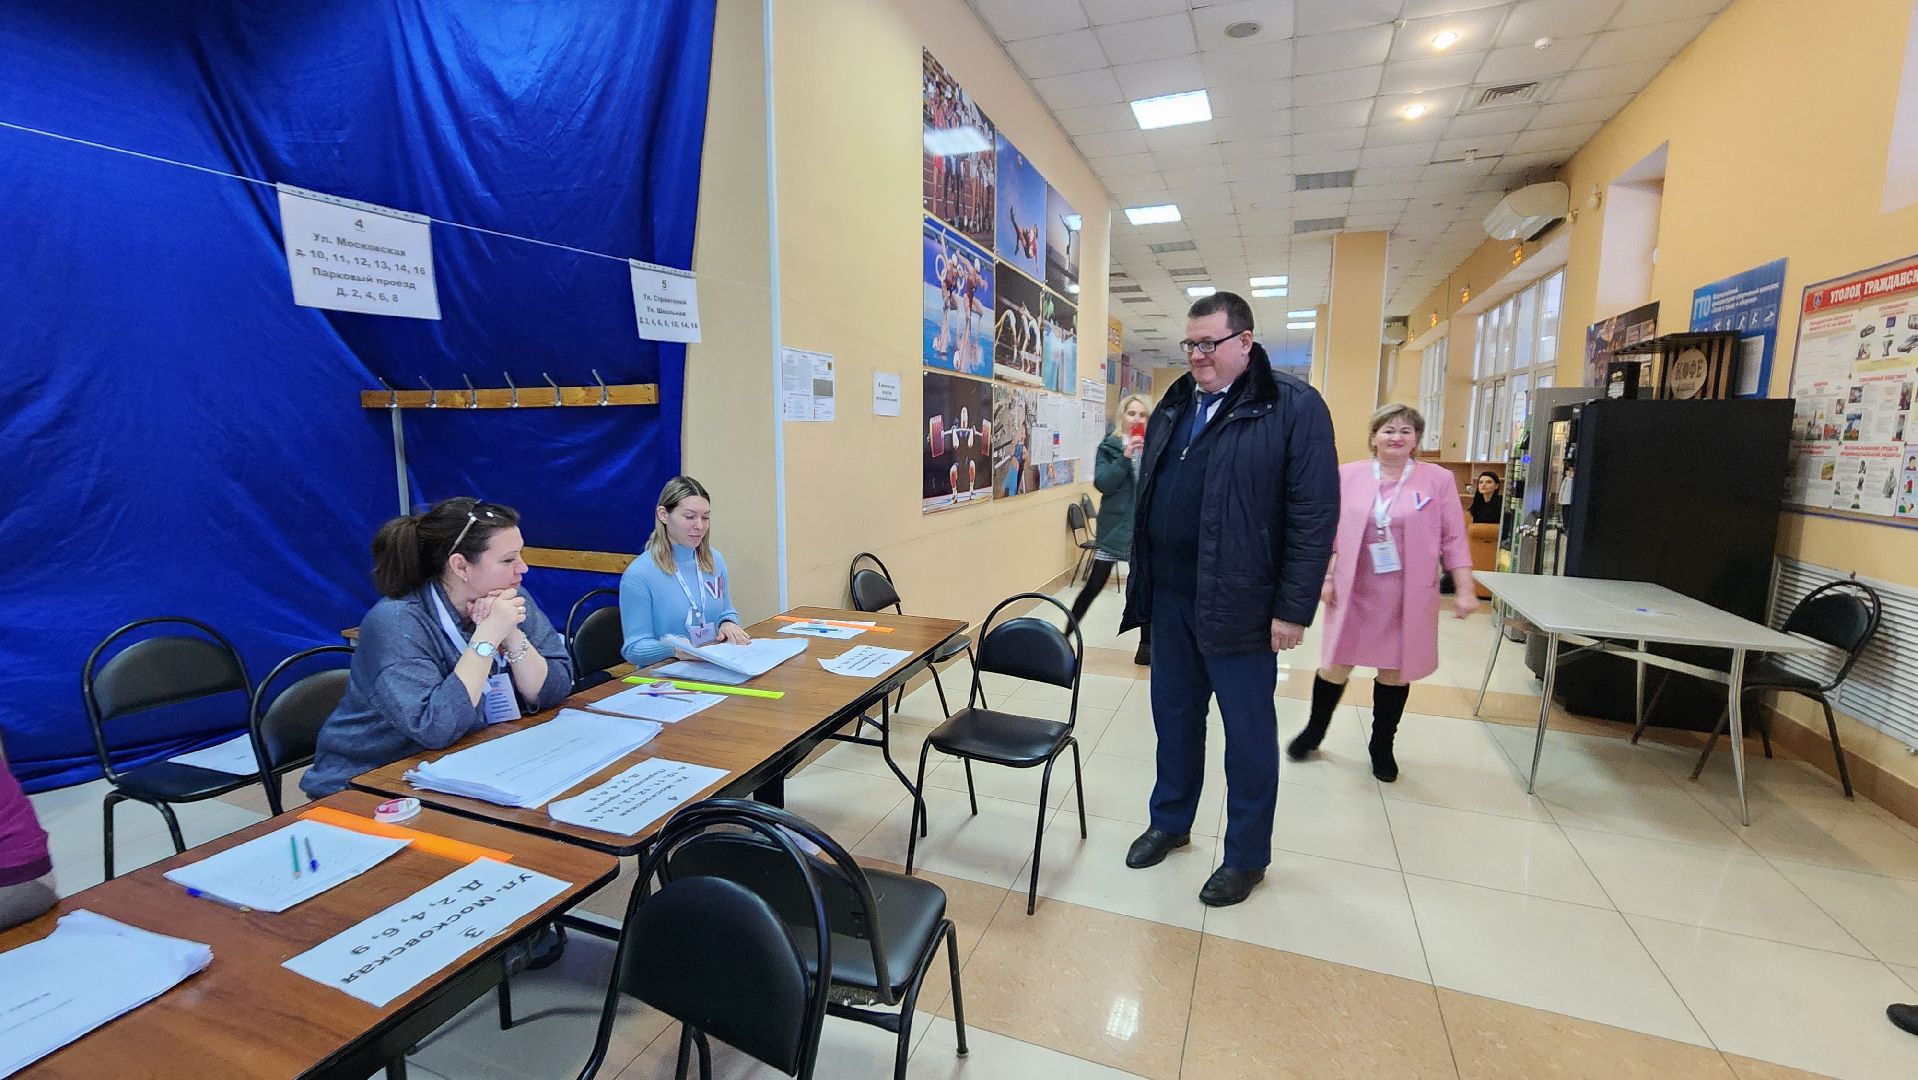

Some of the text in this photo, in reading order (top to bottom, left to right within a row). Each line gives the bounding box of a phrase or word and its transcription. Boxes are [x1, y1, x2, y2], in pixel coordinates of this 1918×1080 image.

[354, 218, 364, 229] 4
[312, 232, 406, 256] Ул. Московская
[310, 249, 329, 261] 10,
[332, 253, 350, 265] 11,
[353, 257, 371, 268] 12,
[374, 259, 391, 271] 13,
[394, 263, 411, 274] 14,
[312, 267, 416, 290] Парковый проезд
[661, 279, 667, 289] 5
[336, 287, 349, 298] Д.
[351, 289, 362, 299] 2,
[365, 291, 376, 301] 4,
[392, 294, 399, 302] 8
[1830, 284, 1861, 304] УГОЛОК
[1694, 295, 1711, 320] ГТО
[1675, 360, 1703, 380] КОФЕ
[351, 879, 484, 955] Д. 2, 4, 6, 9
[340, 873, 534, 984] Ул. Московская
[464, 926, 485, 940] 3
